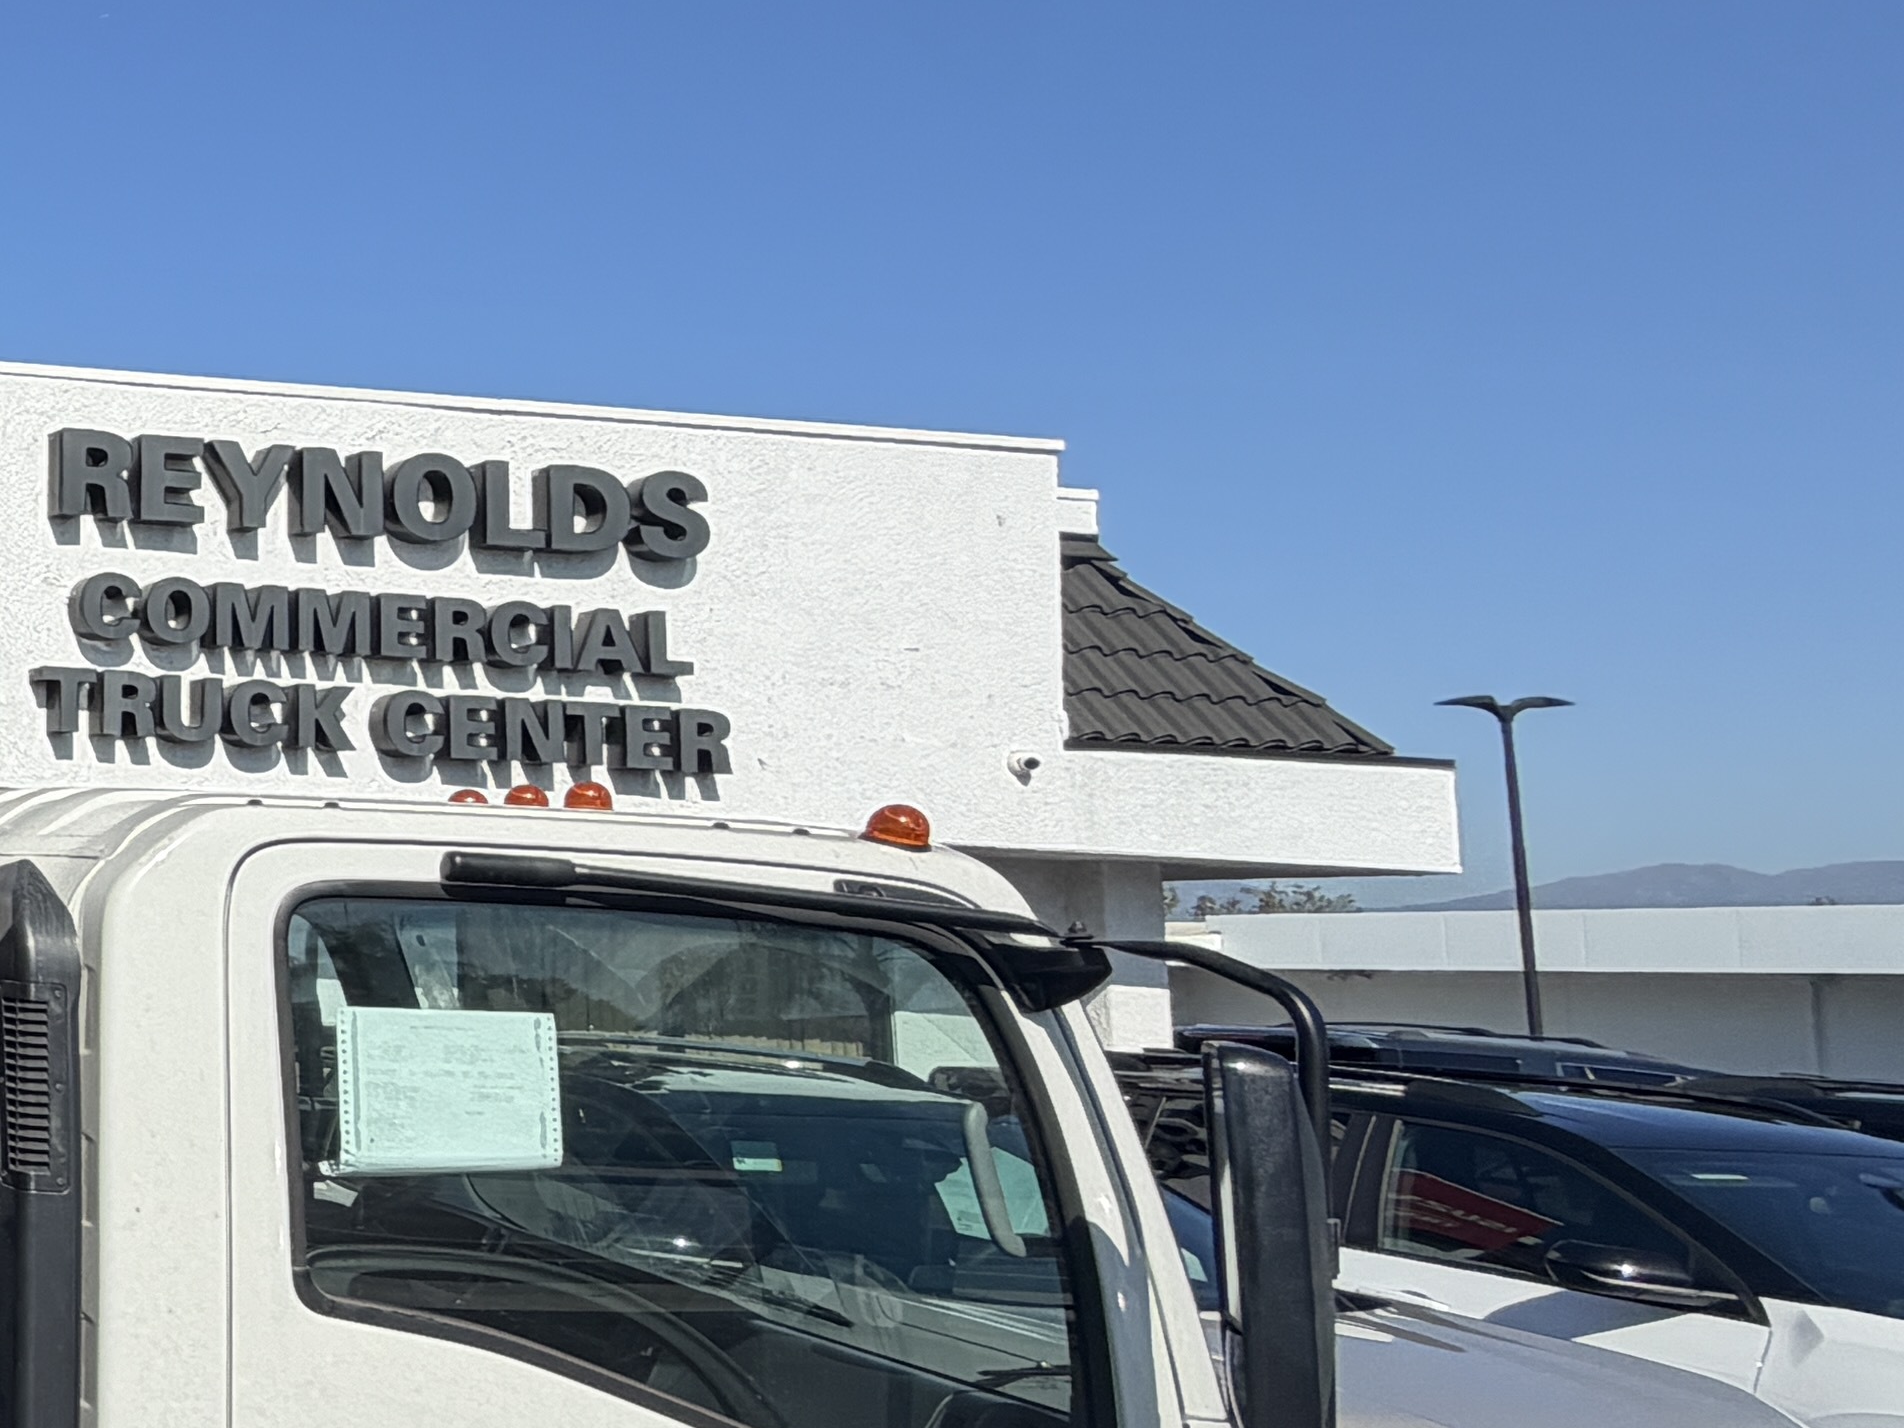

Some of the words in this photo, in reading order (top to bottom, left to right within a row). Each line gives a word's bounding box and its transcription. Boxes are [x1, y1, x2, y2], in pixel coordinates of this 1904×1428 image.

[48, 428, 710, 560] REYNOLDS
[67, 572, 694, 676] COMMERCIAL
[29, 667, 357, 752] TRUCK
[369, 690, 733, 775] CENTER
